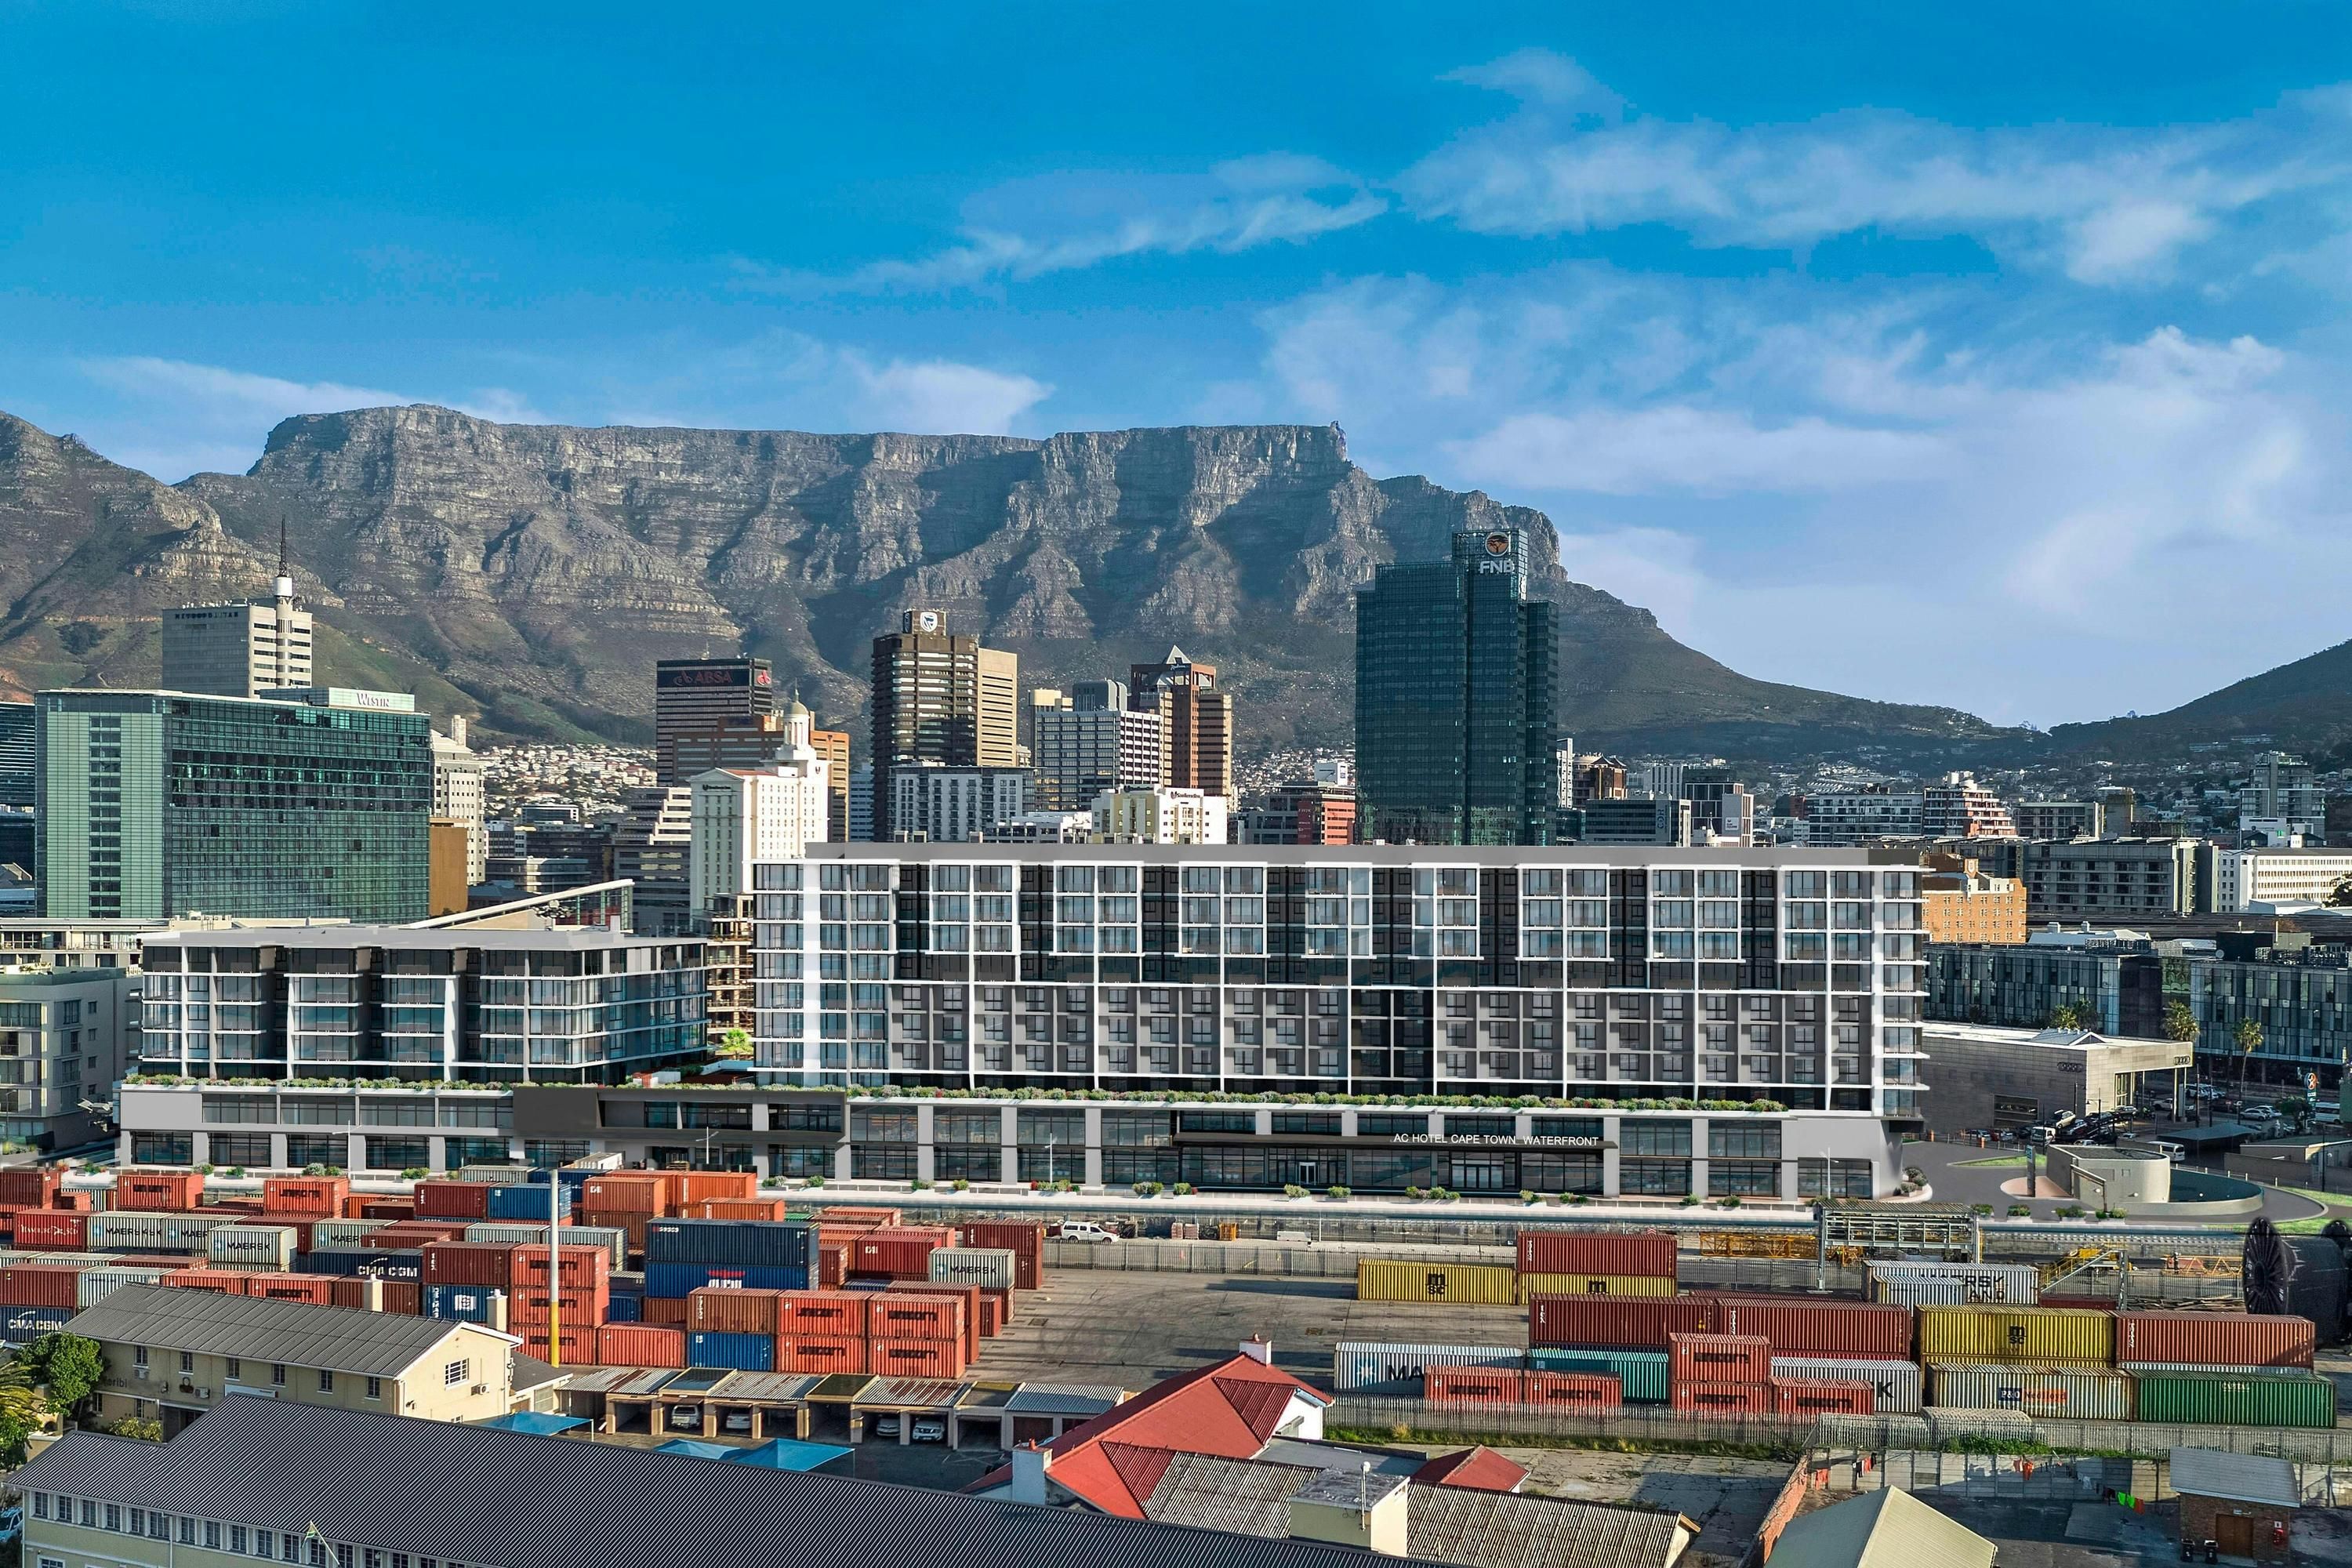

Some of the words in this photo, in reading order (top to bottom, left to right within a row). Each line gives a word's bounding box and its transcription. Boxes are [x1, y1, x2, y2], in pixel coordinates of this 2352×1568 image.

[1479, 560, 1515, 574] FNB
[695, 670, 733, 684] ABSA
[1394, 1134, 1409, 1143] AC
[1412, 1134, 1447, 1144] HOTEL
[1451, 1134, 1480, 1145] CAPE
[1483, 1134, 1516, 1145] TOWN
[1523, 1136, 1599, 1146] WATERFRONT
[181, 1229, 208, 1238] MAER
[331, 1234, 359, 1243] MAER
[227, 1242, 270, 1250] MAERSK
[358, 1266, 384, 1276] CMA
[388, 1267, 417, 1277] CGM
[950, 1266, 997, 1275] MAERSK
[8, 1319, 34, 1330] CMA
[35, 1320, 62, 1330] CGM
[2001, 1390, 2020, 1399] P&O
